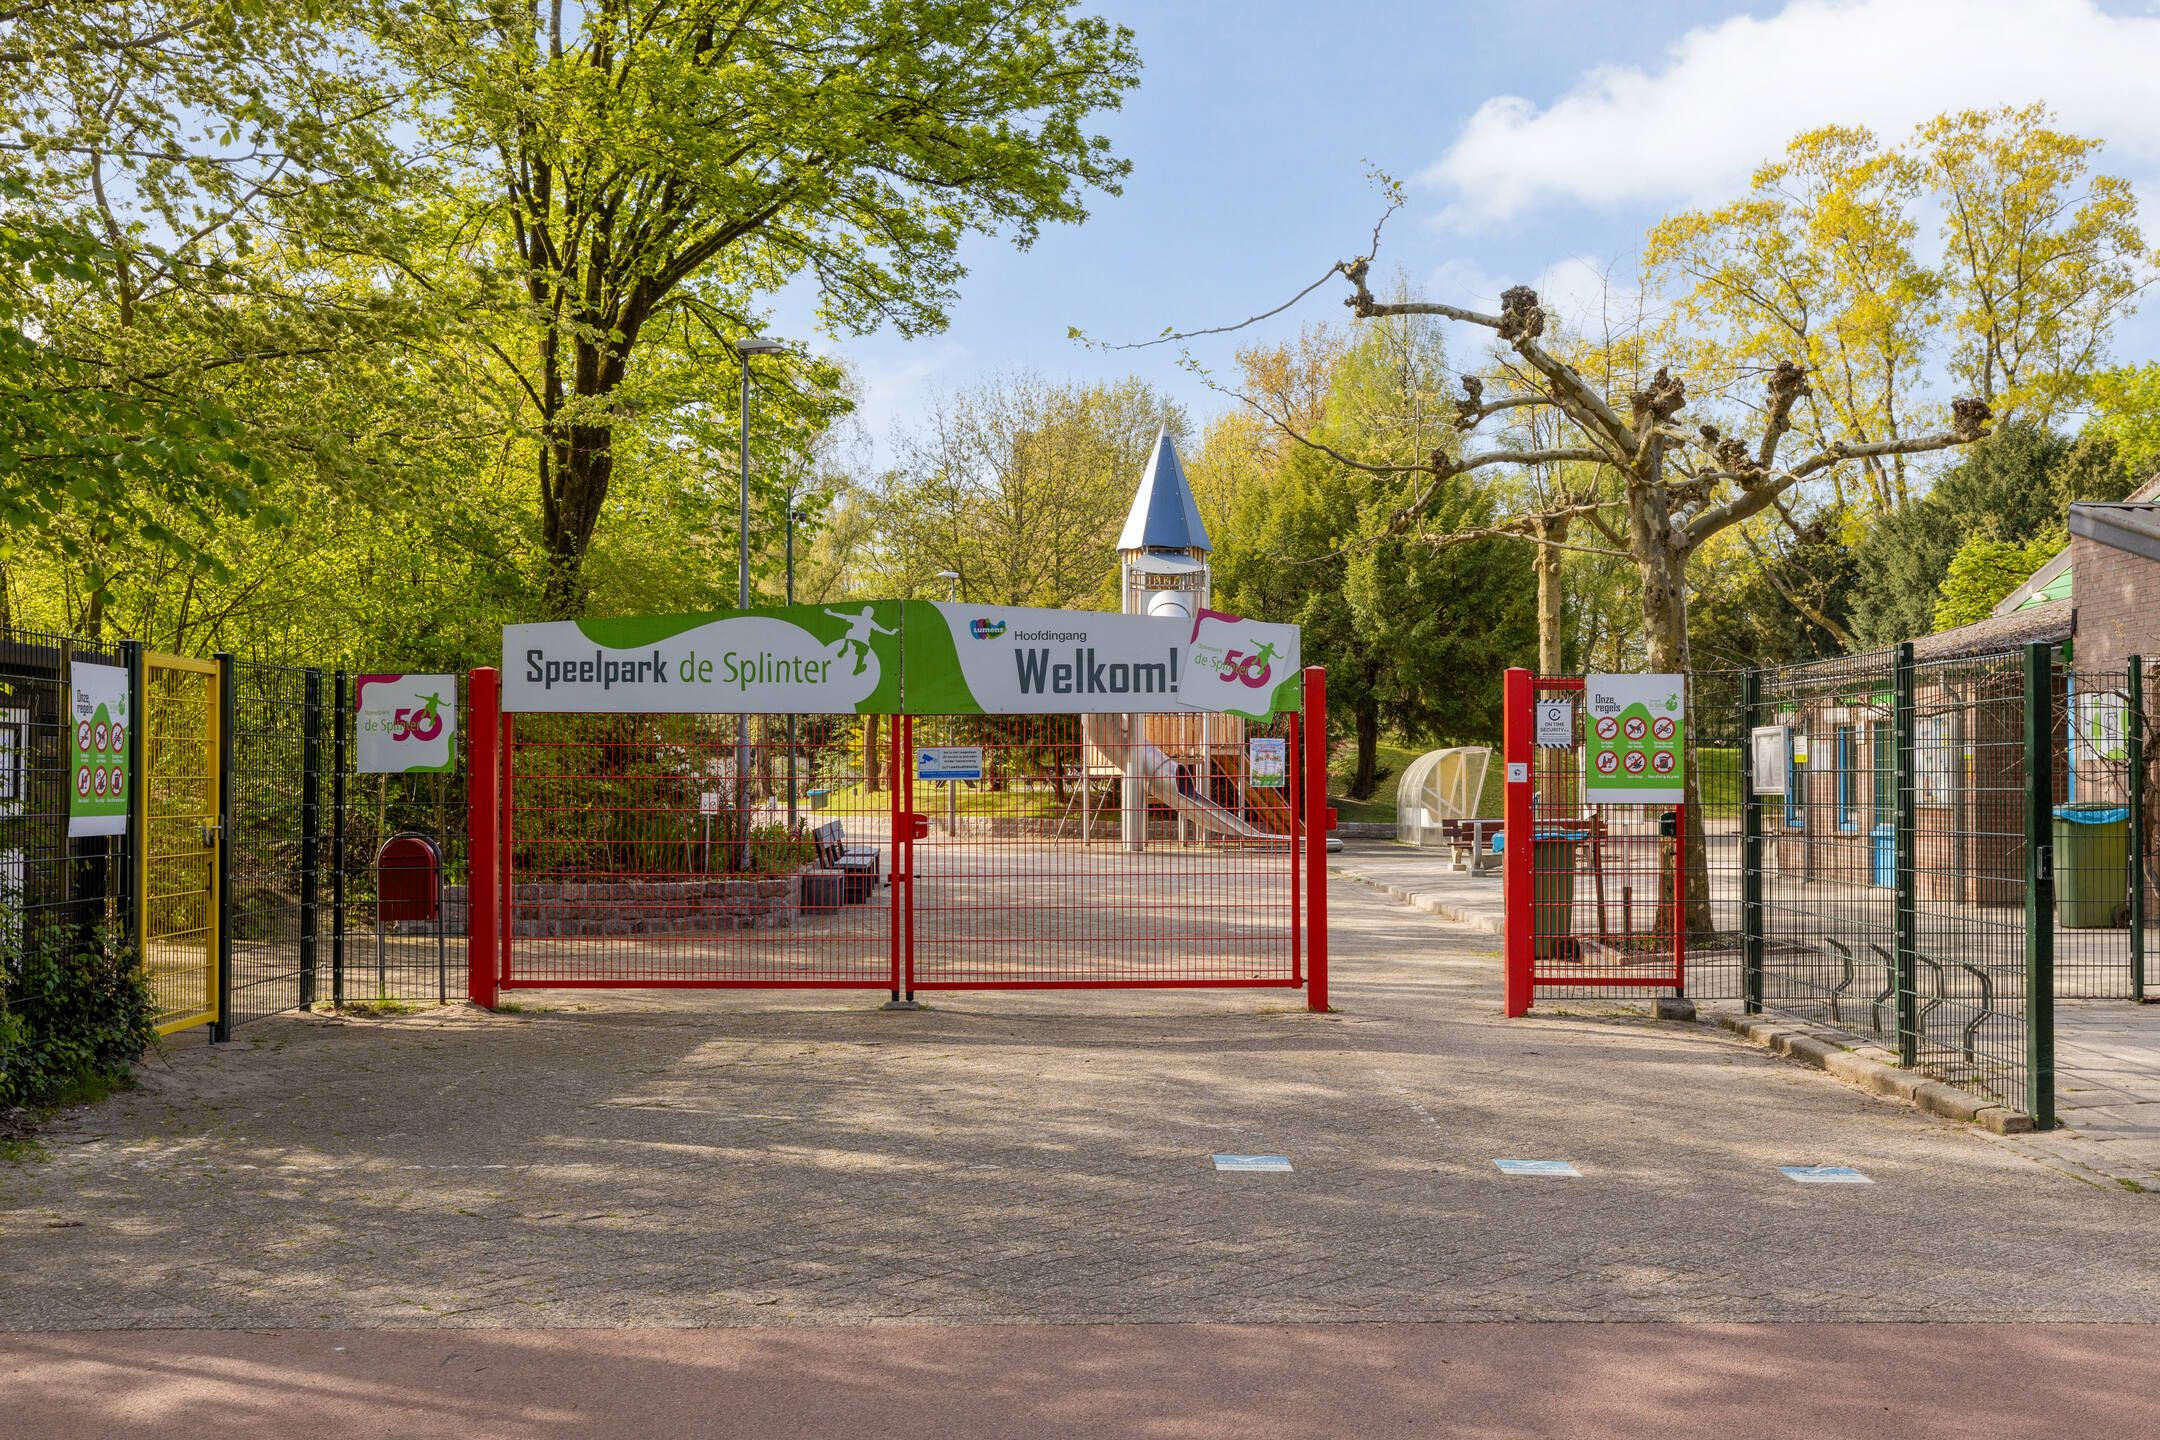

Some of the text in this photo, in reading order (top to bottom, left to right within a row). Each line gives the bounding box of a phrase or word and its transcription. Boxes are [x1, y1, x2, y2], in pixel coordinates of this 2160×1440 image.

[1014, 630, 1087, 643] Hoofdingang
[1194, 653, 1208, 666] de
[526, 650, 832, 691] Speelpark de Splinter
[1014, 647, 1178, 694] Welkom!
[1219, 649, 1272, 689] 50
[1595, 693, 1615, 704] Onze
[1595, 701, 1621, 714] regels
[364, 719, 378, 732] de
[392, 708, 443, 742] 50
